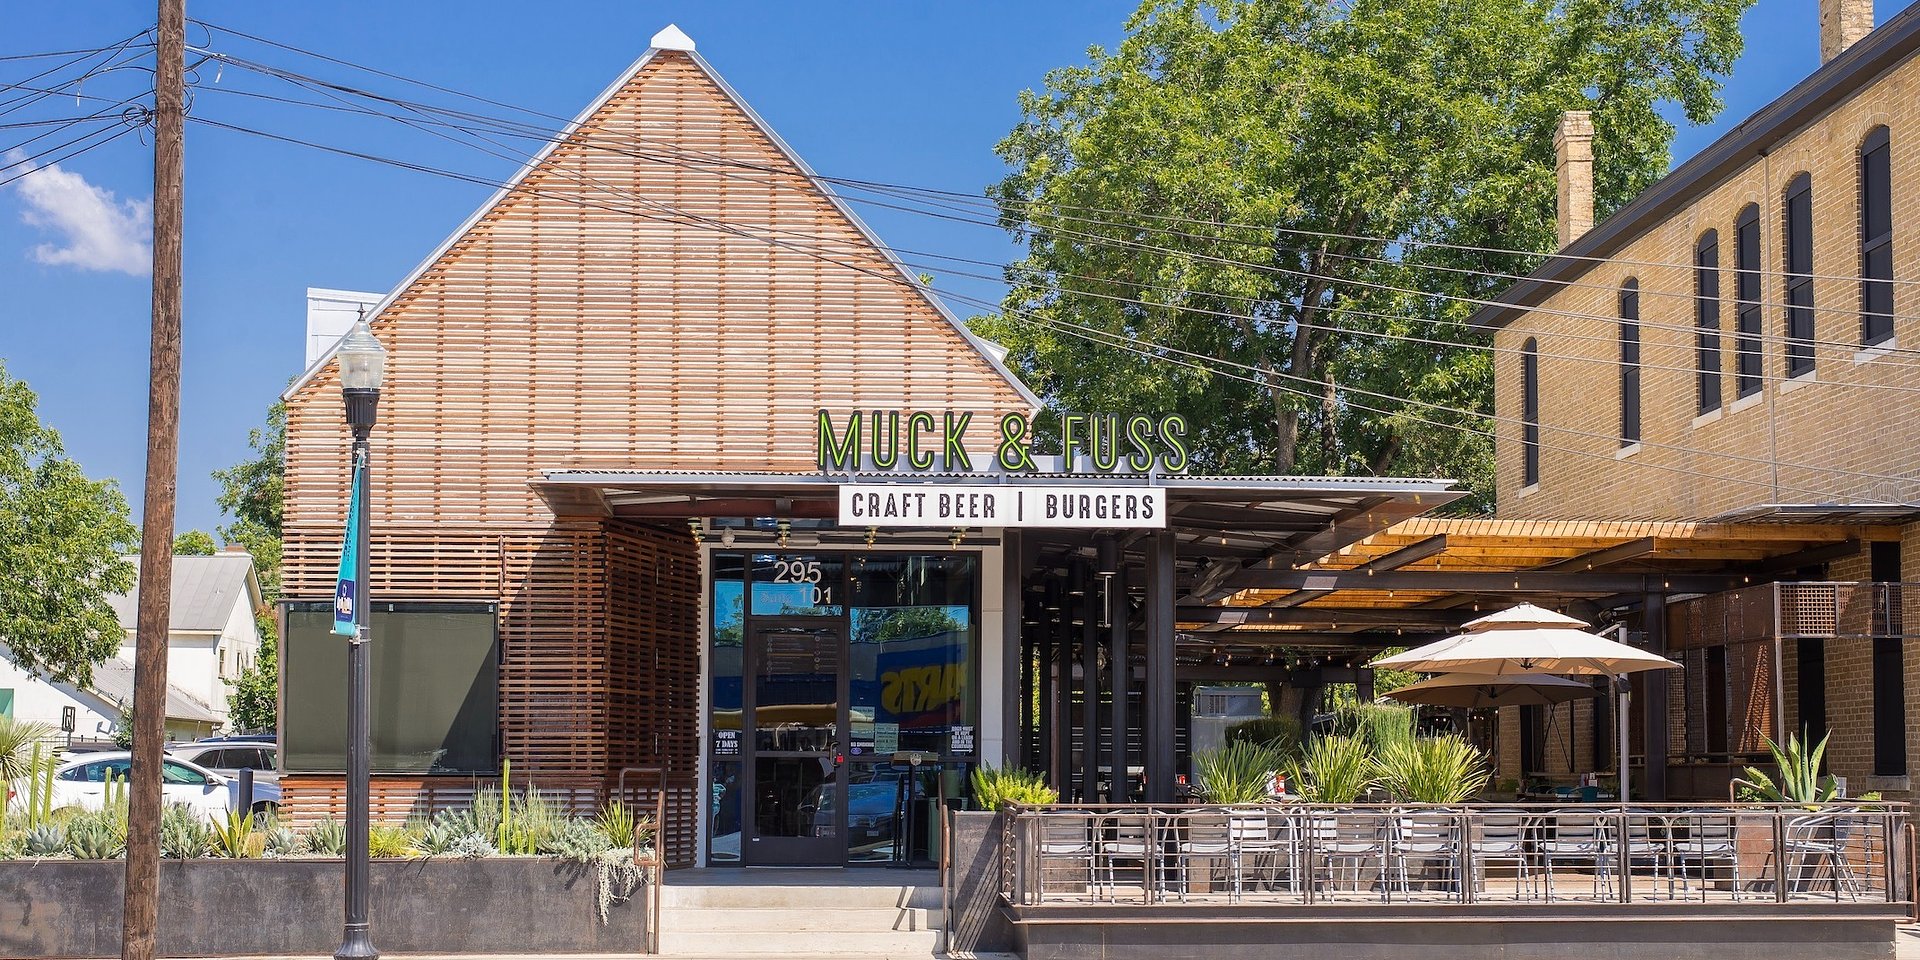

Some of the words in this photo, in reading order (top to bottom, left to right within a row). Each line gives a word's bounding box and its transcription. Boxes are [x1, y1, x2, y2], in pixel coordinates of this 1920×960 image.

[817, 409, 973, 472] MUCK
[998, 411, 1038, 473] &
[1063, 411, 1190, 474] FUSS
[851, 492, 926, 519] CRAFT
[939, 493, 996, 519] BEER
[1046, 493, 1155, 520] BURGERS
[774, 560, 822, 584] 295
[800, 586, 832, 604] 101
